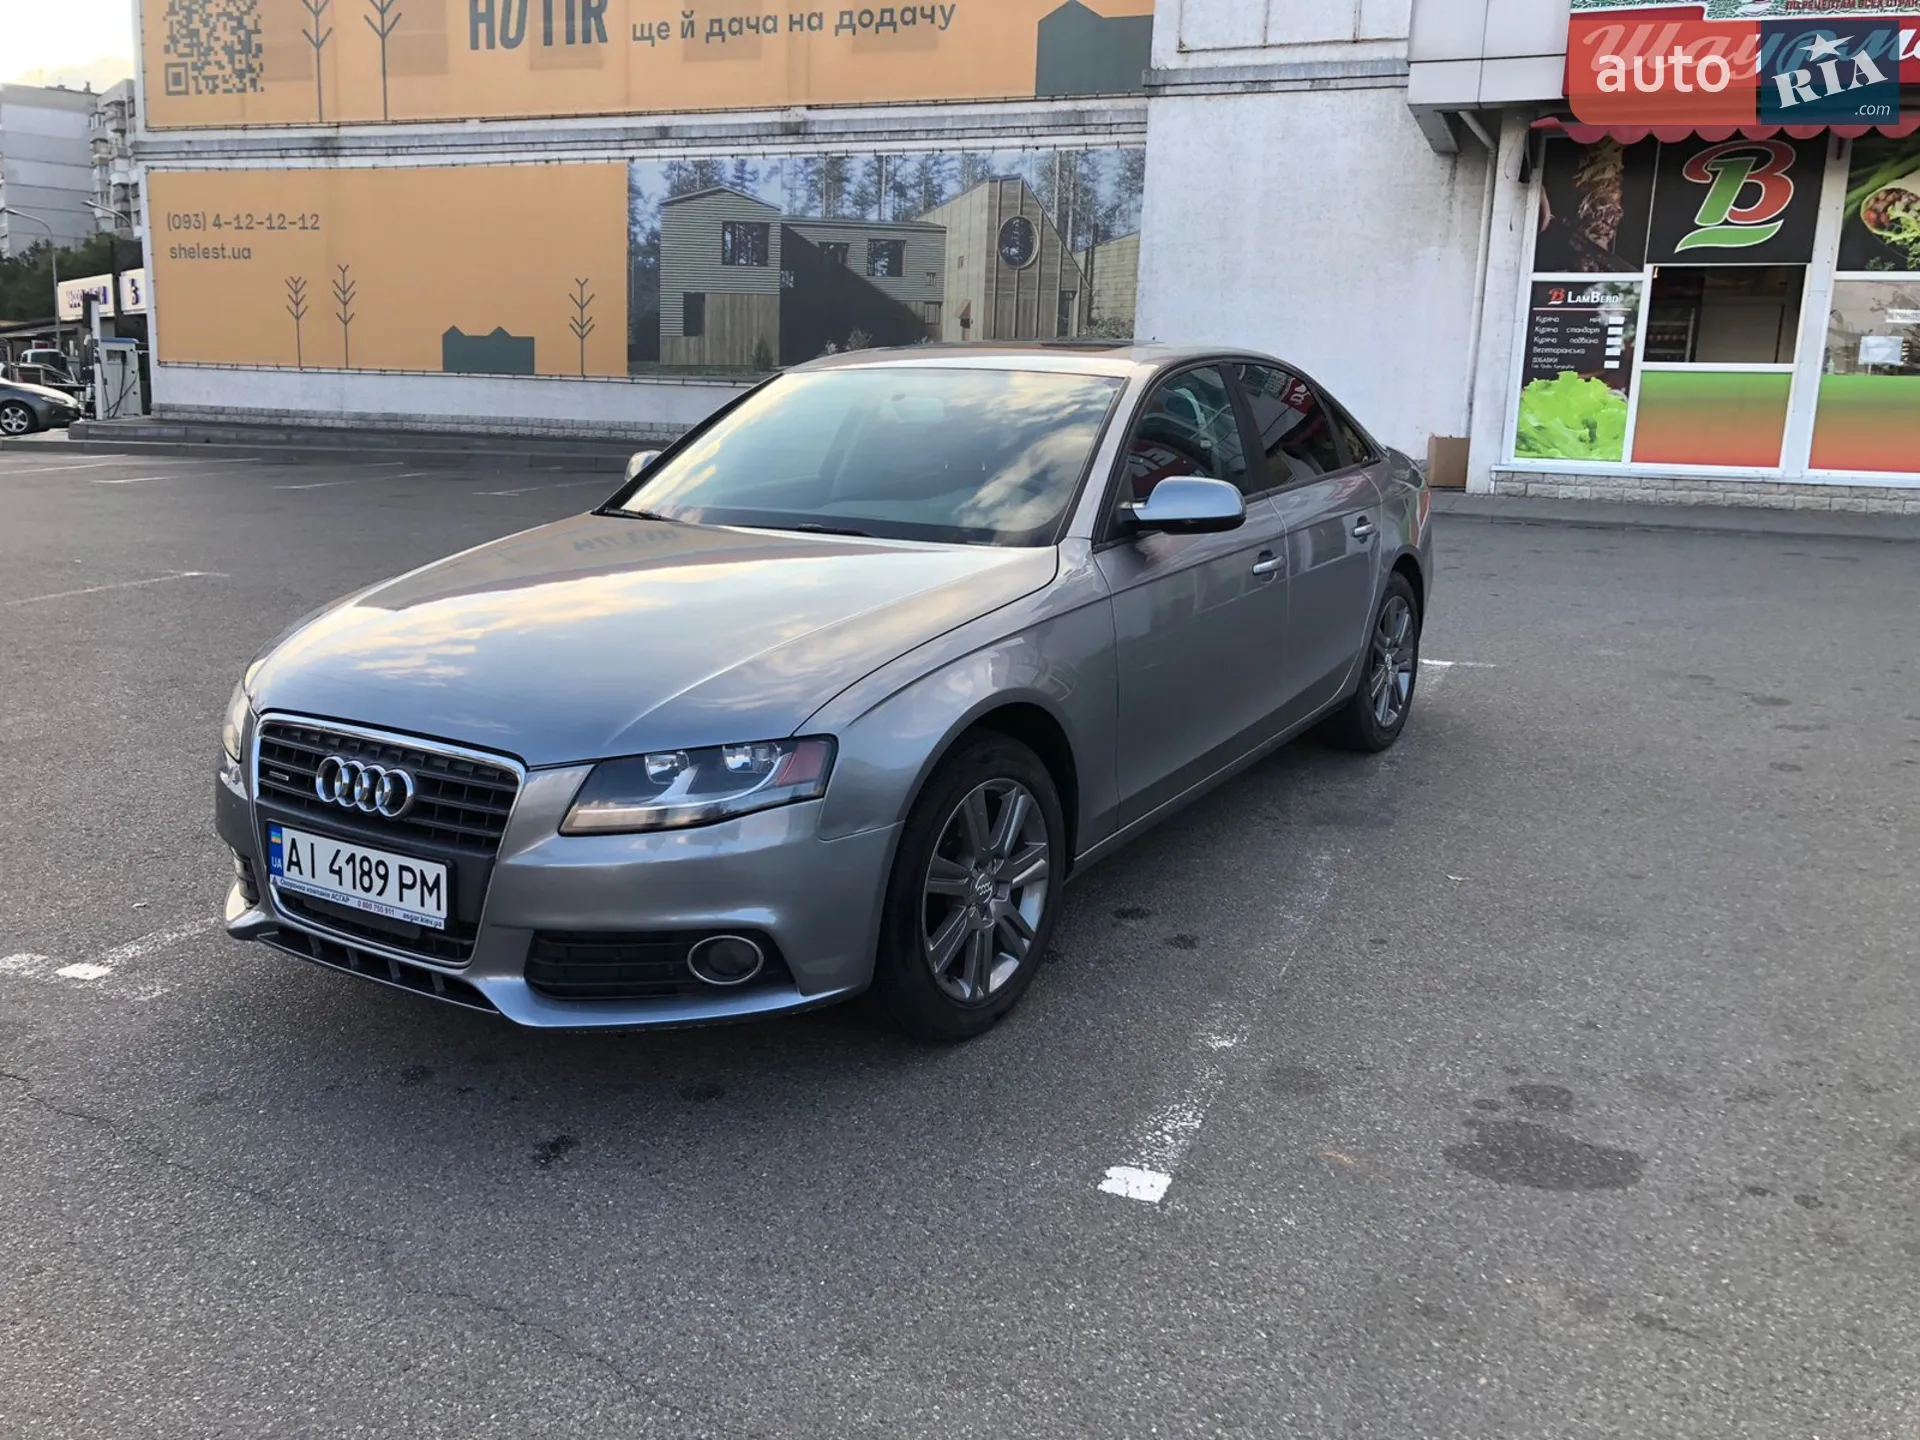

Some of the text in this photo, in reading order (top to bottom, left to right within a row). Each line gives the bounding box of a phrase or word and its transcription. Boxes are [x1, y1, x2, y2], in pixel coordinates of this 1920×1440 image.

[632, 3, 956, 47] ще й дача на додачу
[167, 211, 320, 232] (093) 4-12-12-12
[169, 242, 252, 260] shelest.ua
[271, 856, 283, 869] UA
[286, 837, 442, 911] AI 4189 PM
